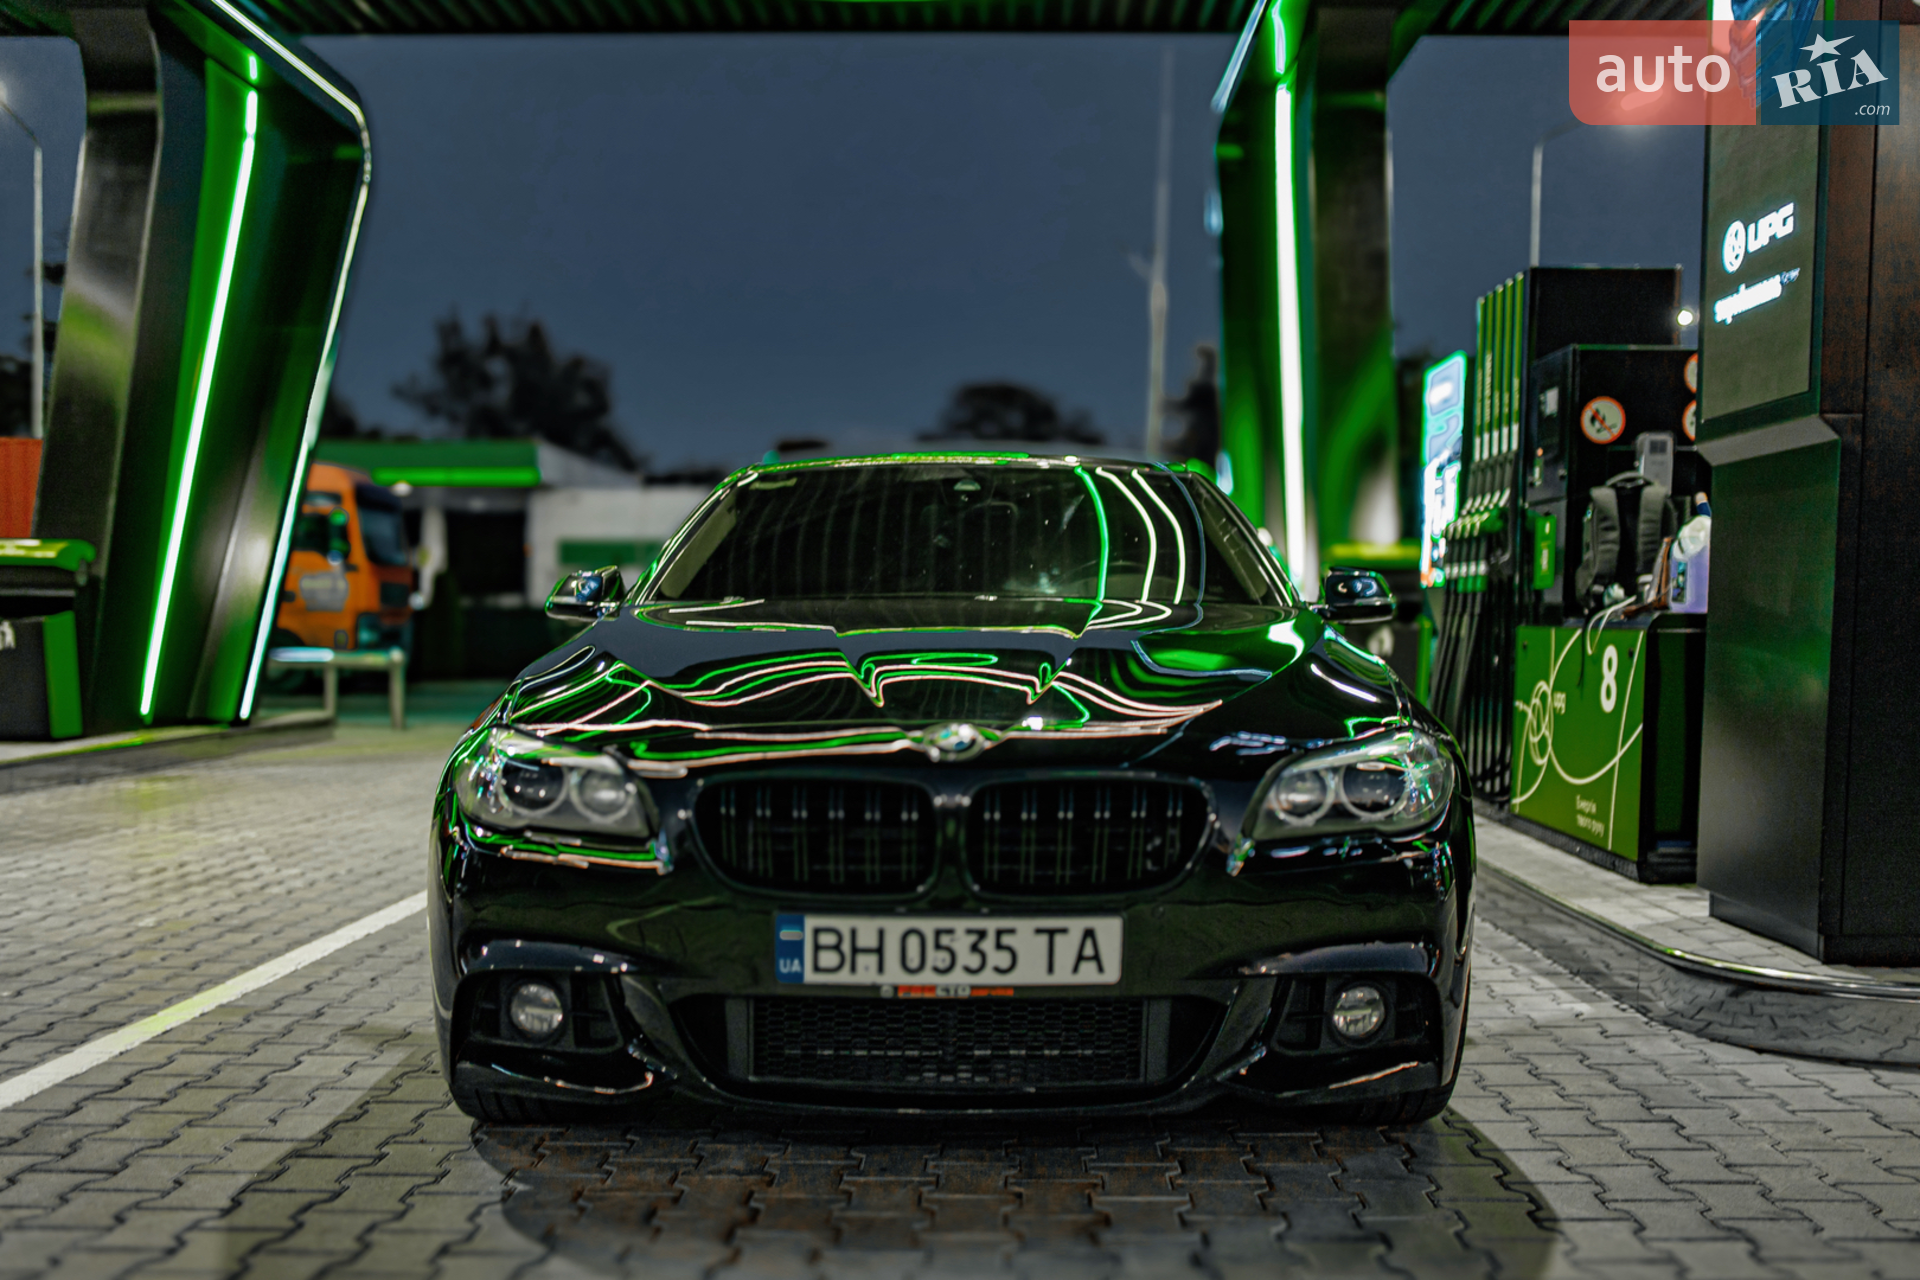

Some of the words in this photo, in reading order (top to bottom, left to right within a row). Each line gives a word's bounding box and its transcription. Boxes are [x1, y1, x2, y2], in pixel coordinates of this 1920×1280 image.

[1746, 202, 1794, 254] UPG
[1601, 644, 1618, 713] 8
[779, 958, 802, 974] UA
[812, 927, 884, 975] BH
[901, 927, 1018, 975] 0535
[1034, 927, 1105, 975] TA
